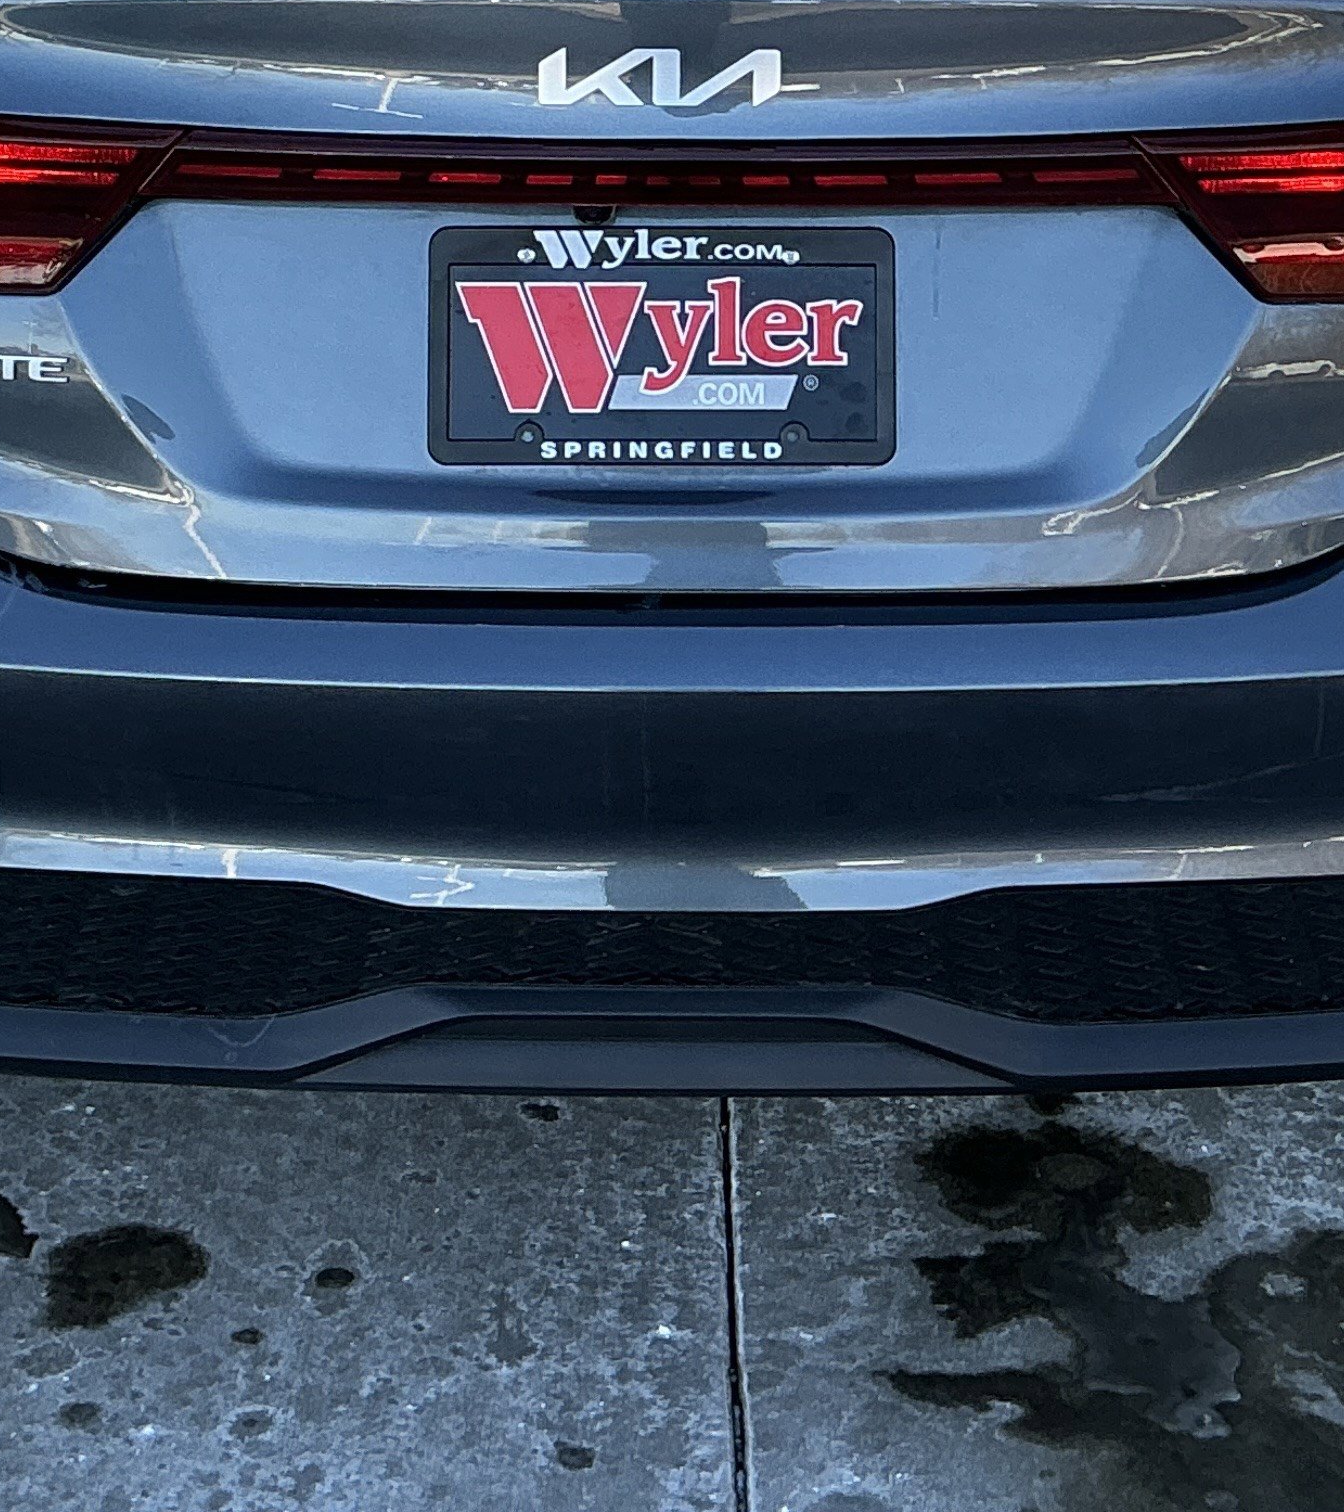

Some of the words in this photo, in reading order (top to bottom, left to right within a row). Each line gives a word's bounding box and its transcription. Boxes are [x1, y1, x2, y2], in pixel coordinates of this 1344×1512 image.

[538, 46, 782, 106] KIA
[455, 276, 865, 414] Wyler
[540, 441, 784, 460] SPRINGFIELD
